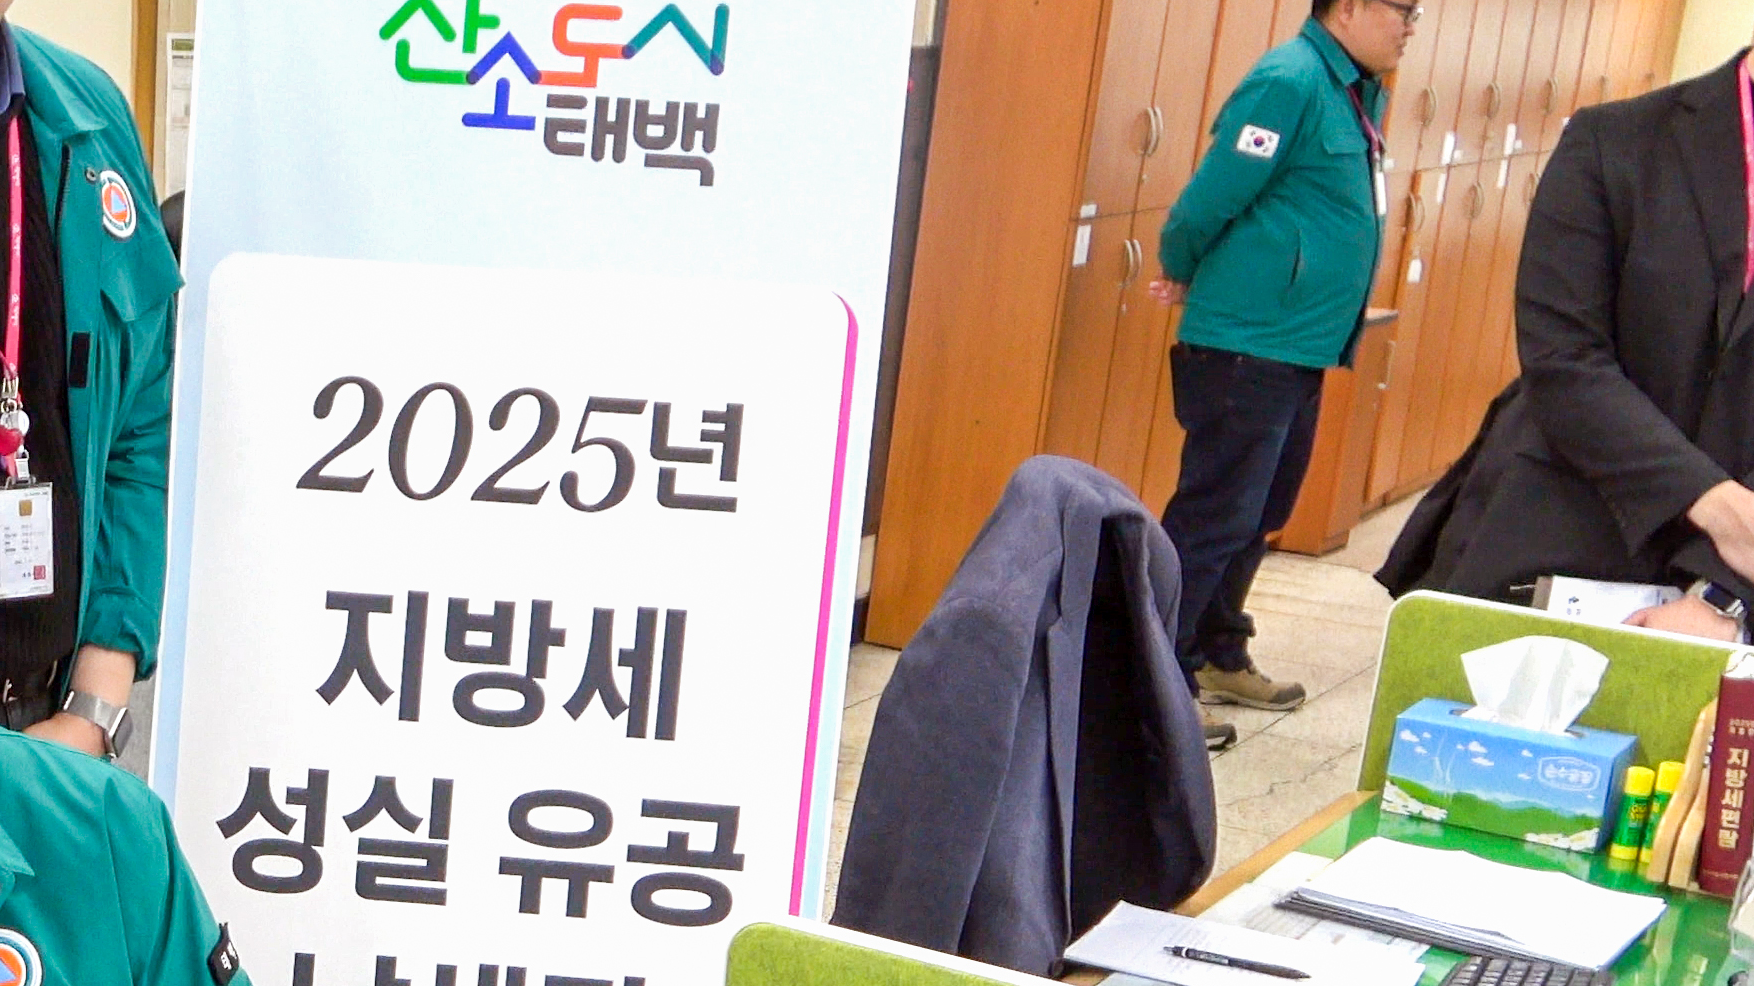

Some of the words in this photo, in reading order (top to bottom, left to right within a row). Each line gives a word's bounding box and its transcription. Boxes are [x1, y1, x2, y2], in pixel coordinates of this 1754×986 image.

[543, 92, 720, 187] 태백
[296, 375, 745, 513] 2025년
[315, 589, 688, 741] 지방세
[215, 766, 455, 906] 성실
[498, 789, 746, 927] 유공
